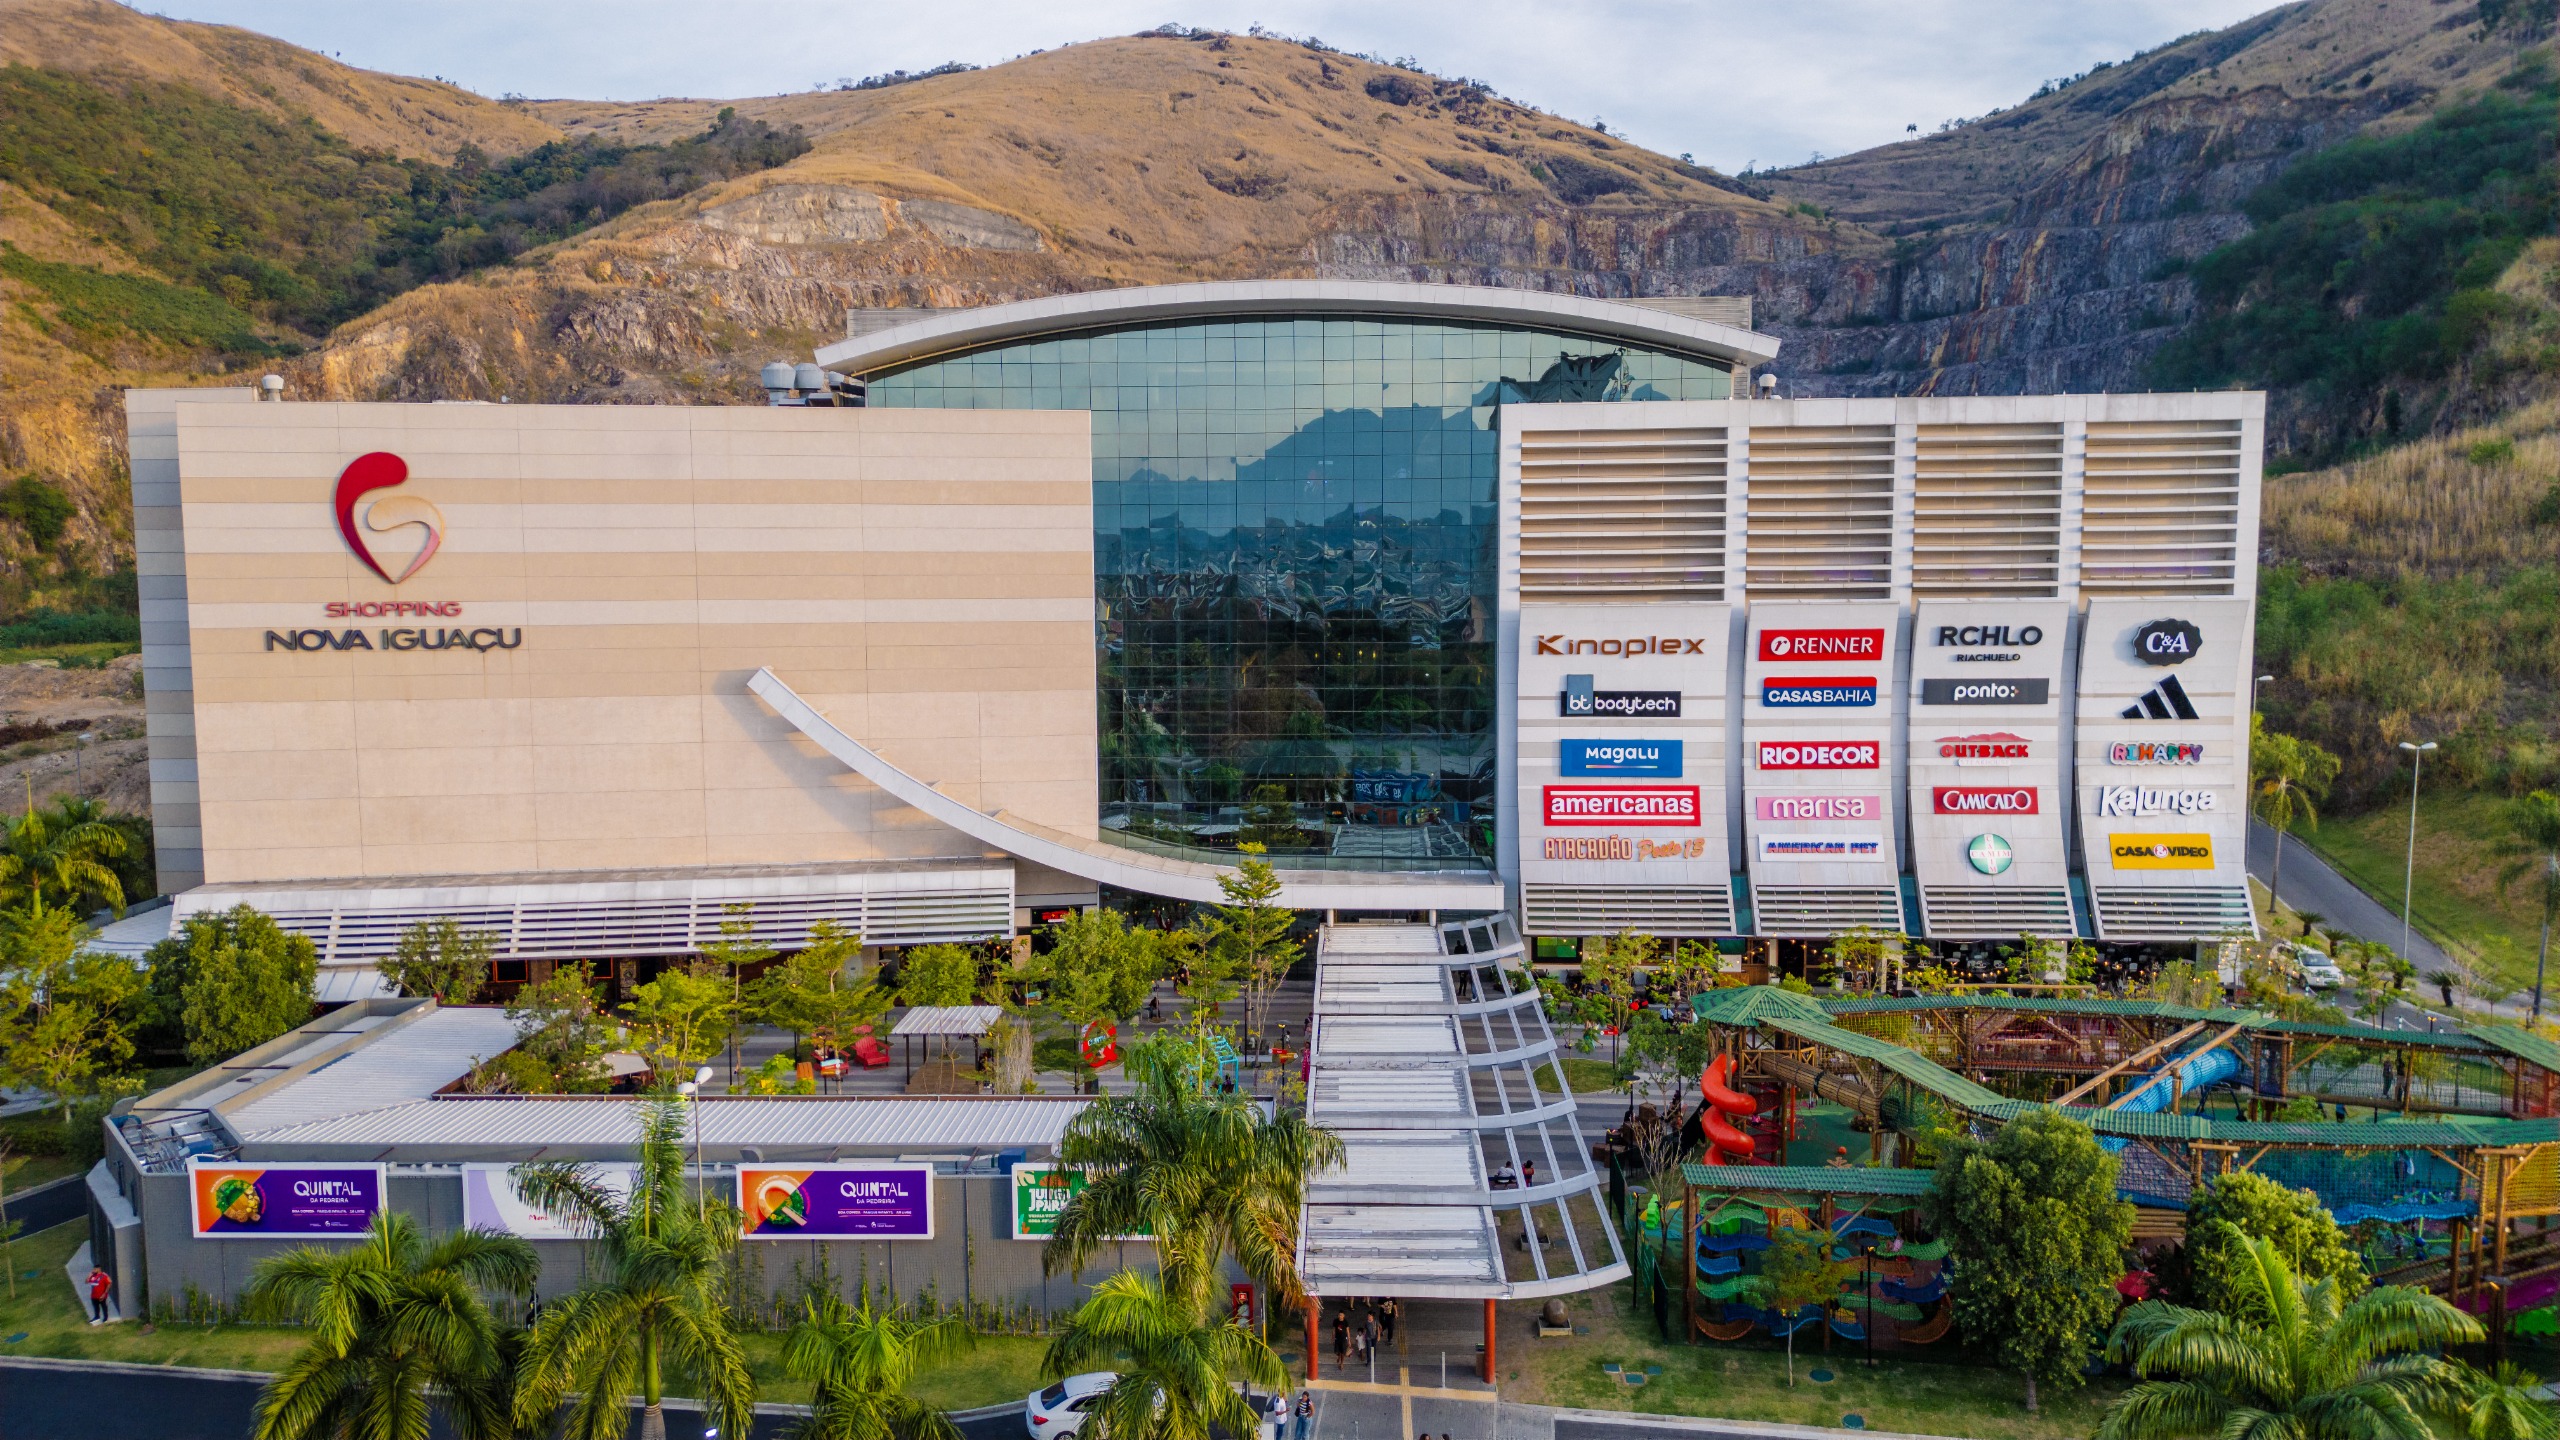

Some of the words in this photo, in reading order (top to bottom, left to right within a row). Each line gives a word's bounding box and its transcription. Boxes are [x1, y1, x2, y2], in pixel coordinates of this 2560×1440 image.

[325, 602, 462, 618] SHOPPING
[266, 629, 373, 651] NOVA
[382, 628, 522, 653] IGUAÇU
[1795, 637, 1873, 654] RENNER
[1939, 626, 2043, 647] RCHLO
[2146, 632, 2190, 653] C&A
[1537, 634, 1706, 659] Kinoplex
[1956, 653, 2021, 662] RIACHUELO
[1569, 694, 1592, 711] bt
[1594, 697, 1676, 713] bodytech
[1762, 747, 1799, 765] RIO
[1802, 747, 1875, 764] DECOR
[1940, 744, 2029, 758] OUTBACK
[1551, 795, 1694, 814] americanas
[1772, 799, 1866, 818] marisa
[1943, 790, 2031, 810] CAMICADO
[1545, 834, 1632, 860] ATACADÃO
[294, 1181, 361, 1196] QUINTAL
[840, 1181, 908, 1197] QUINTAL
